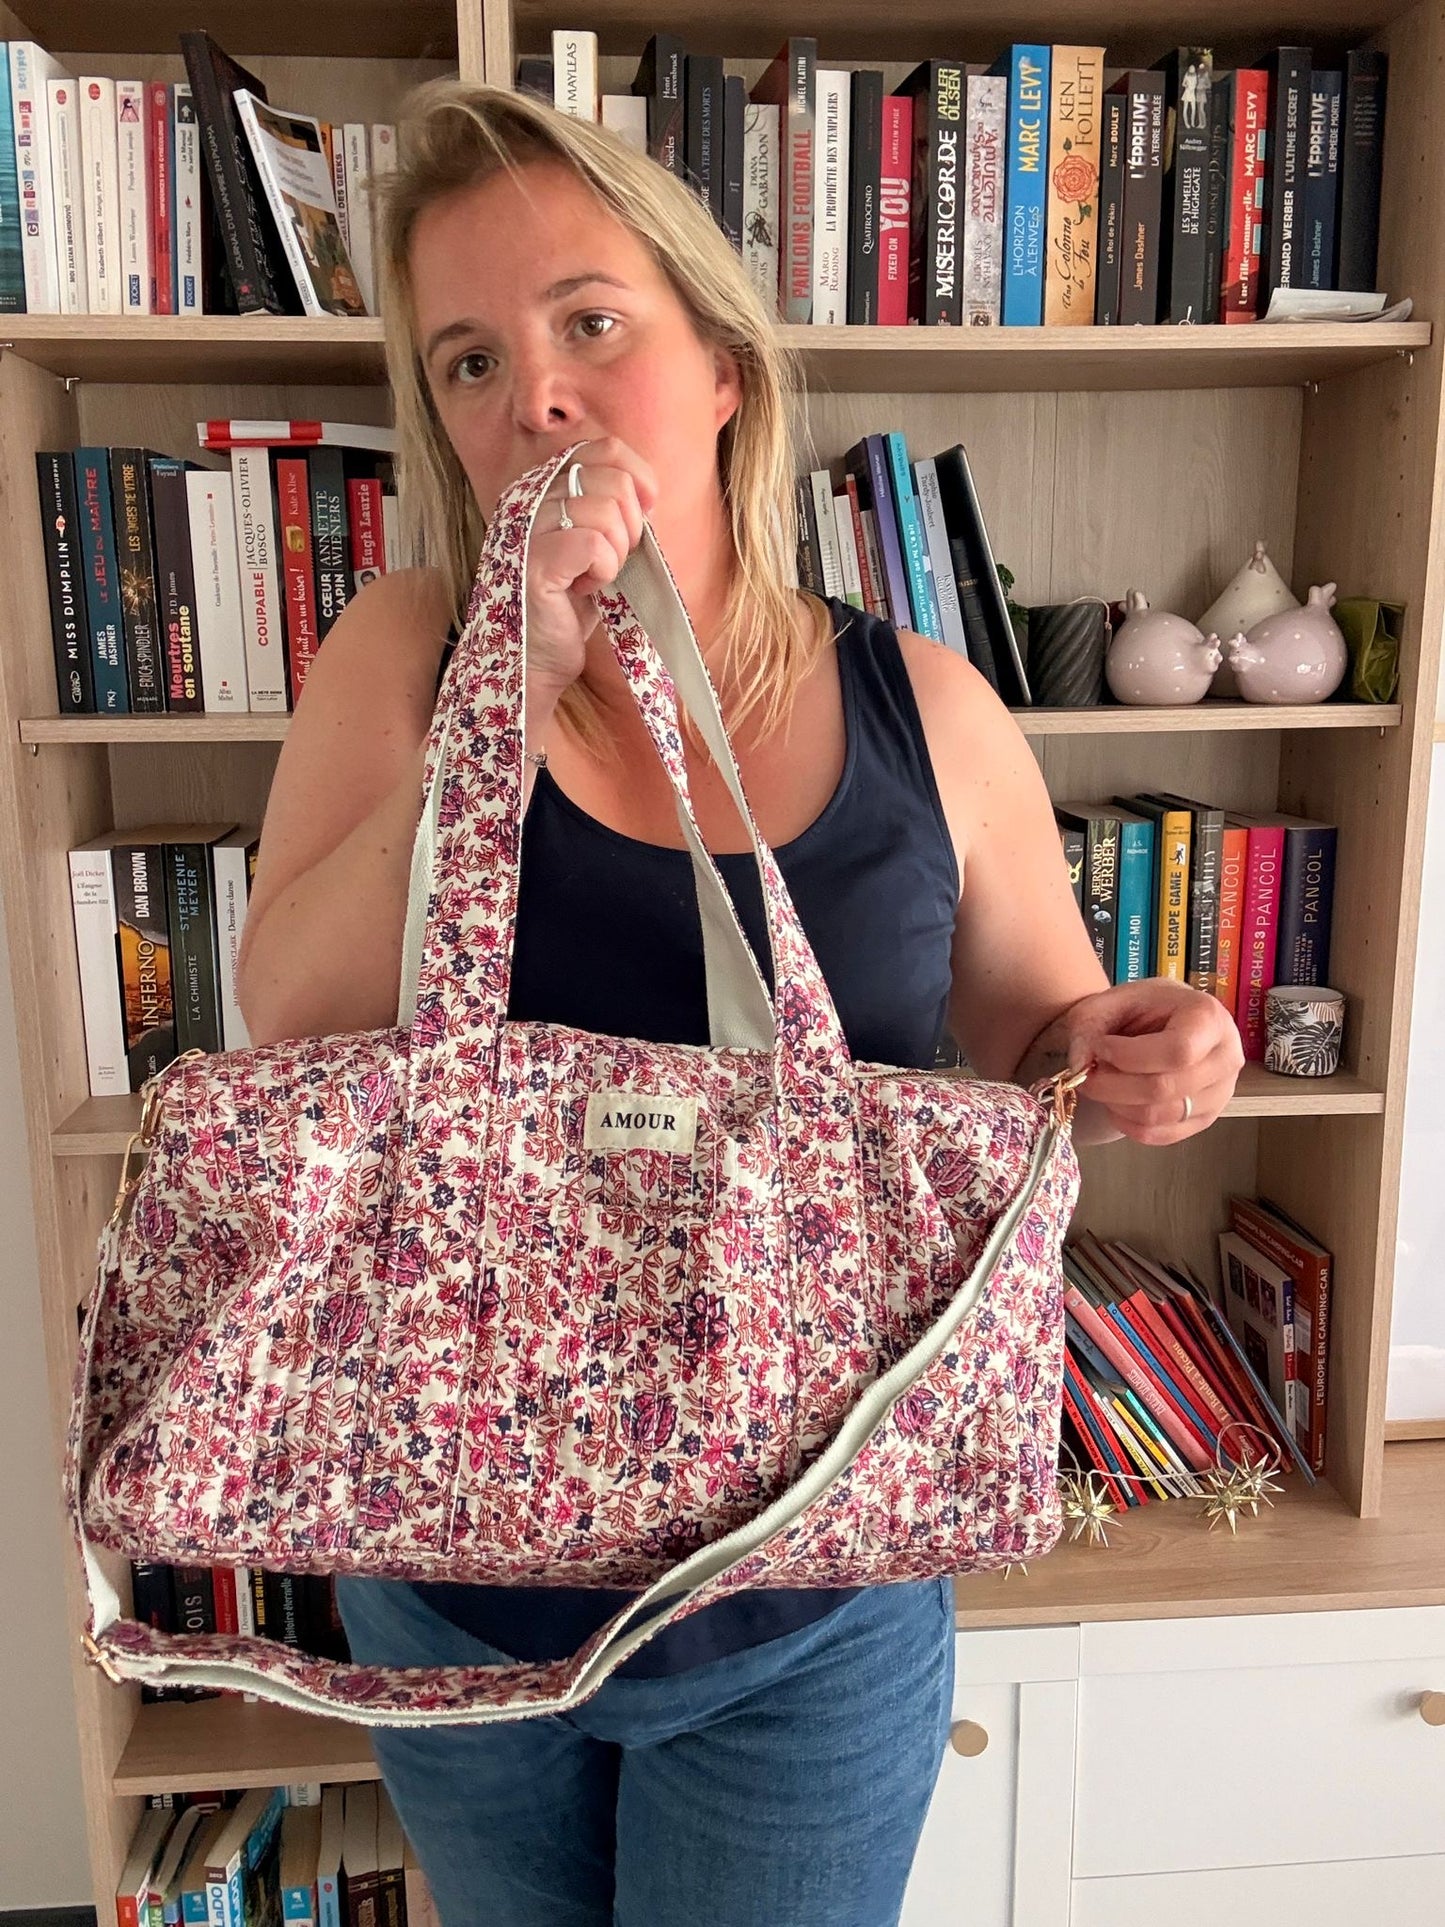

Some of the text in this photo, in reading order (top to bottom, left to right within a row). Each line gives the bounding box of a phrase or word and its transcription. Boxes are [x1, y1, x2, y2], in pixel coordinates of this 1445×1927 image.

[566, 42, 577, 102] MAYLEAS
[662, 76, 671, 99] Henri
[796, 56, 807, 114] MICHEL PLATINI
[938, 67, 949, 117] ADLER
[948, 68, 961, 121] OLSEN
[1018, 62, 1042, 173] MARC LEVY
[1060, 80, 1075, 123] KEN
[1075, 56, 1096, 147] FOLLETT
[665, 136, 675, 168] Siècles
[702, 86, 712, 181] LA TERRE DES MORTS
[1109, 106, 1119, 168] Marc BOULET
[1130, 92, 1149, 180] L'ÉPREUVE
[1151, 127, 1161, 153] TERRE
[1151, 153, 1160, 167] LA
[1243, 90, 1257, 177] MARC LEVY
[1307, 92, 1328, 178] L'ÉPREUVE
[1328, 93, 1341, 173] LE MORTEL
[334, 153, 346, 210] DES GEEKS
[750, 156, 759, 187] DIANA
[758, 133, 769, 209] GABALDON
[825, 92, 838, 232] LA PROPHÉTIE DES TEMPLIERS
[1281, 87, 1298, 290] ERNARD WERBER L'ULTIME SECRET
[224, 208, 236, 230] D'UN
[792, 129, 812, 299] PARLONS FOOTBALL
[862, 184, 874, 255] QUATTROCENTO
[1182, 167, 1192, 234] LES JUMELLES
[1190, 166, 1201, 234] DE HIGHGATE
[230, 231, 244, 271] JOURNAL
[879, 176, 909, 281] FIXED ON YOU
[1013, 204, 1025, 276] L'HORIZON
[1054, 216, 1074, 281] Colonne
[1106, 203, 1116, 264] Le Roi de Pékin
[1238, 189, 1253, 282] fille comme elle
[1310, 219, 1322, 288] James Dashner
[67, 246, 75, 269] ZLATAN
[98, 247, 106, 279] Elizabeth
[819, 251, 829, 287] MARIO
[829, 247, 840, 292] READING
[974, 240, 983, 282] STROUD
[982, 233, 993, 289] JONATHAN
[1026, 266, 1038, 276] À
[1072, 238, 1090, 279] Feu
[1134, 222, 1146, 291] James Dashner
[184, 277, 194, 306] POCKET
[52, 458, 60, 484] MURPHY
[55, 486, 63, 511] JULIE
[121, 462, 135, 487] VERRE
[927, 472, 938, 500] Sophie
[238, 457, 256, 567] JACQUES-OLIVIER
[289, 497, 300, 516] Kate
[316, 490, 330, 568] ANNETTE
[356, 483, 375, 567] Hugh Laurie
[920, 474, 936, 529] Tardy-Joubert
[84, 466, 109, 604] LE JEU DU MAÎTRE
[130, 531, 142, 552] LES
[256, 523, 268, 565] BOSCO
[328, 494, 341, 565] WIENERS
[58, 541, 74, 616] DUMPLIN
[298, 574, 309, 604] baiser
[320, 573, 333, 619] CŒUR
[332, 573, 346, 618] LAPIN
[168, 571, 185, 700] Meurtres James
[253, 573, 269, 647] COUPABLE
[64, 622, 79, 660] MISS
[97, 630, 108, 660] JAMES
[106, 623, 119, 666] DASHNER
[133, 623, 152, 664] SPINDLER
[179, 605, 197, 700] en soutane
[298, 636, 316, 661] finit
[137, 663, 155, 690] ERICA
[175, 854, 190, 931] STEPHENIE
[187, 868, 200, 917] MEYER
[226, 879, 235, 902] danse
[1091, 842, 1104, 897] BERNARD
[1100, 836, 1117, 903] WERBER
[1169, 871, 1183, 907] GAME
[1220, 850, 1241, 930] PANCOL
[1256, 847, 1277, 927] PANCOL
[1303, 848, 1323, 924] PANCOL
[131, 851, 160, 1027] INFERNO DAN BROWN
[227, 903, 236, 932] Dernière
[1167, 910, 1181, 957] ESCAPE
[1254, 930, 1266, 939] 3
[1127, 914, 1142, 983] TROUVEZ-MOI
[188, 954, 200, 1021] LA CHIMISTE
[1247, 940, 1265, 1029] MUCHACHAS
[600, 1111, 676, 1131] AMOUR
[1172, 1342, 1195, 1373] Picsou
[1314, 1267, 1329, 1407] L'EUROPE EN CAMPING-CAR
[1198, 1378, 1221, 1408] Bande
[1219, 1405, 1231, 1421] La
[255, 1584, 265, 1599] SUR
[284, 1611, 298, 1644] Histoire
